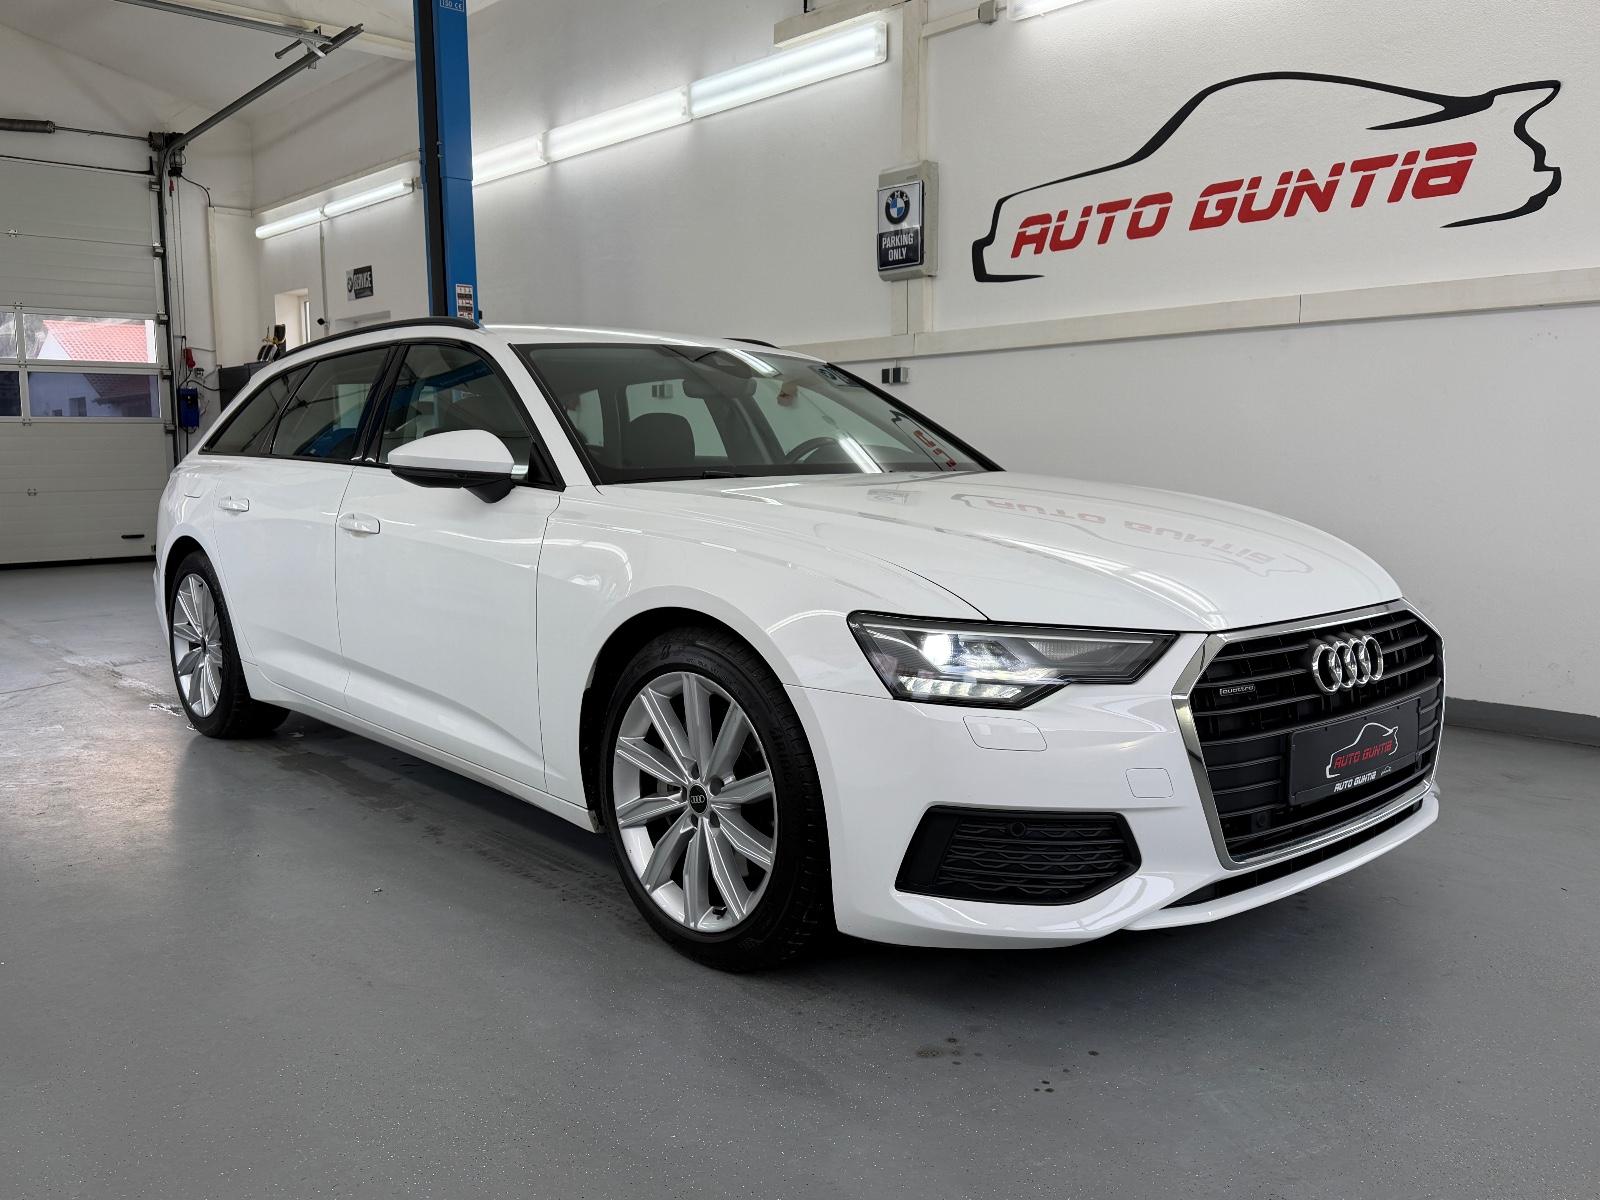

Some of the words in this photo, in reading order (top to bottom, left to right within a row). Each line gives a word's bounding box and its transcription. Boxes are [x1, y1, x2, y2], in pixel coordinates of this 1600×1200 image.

[1010, 191, 1174, 258] AUTO
[882, 233, 913, 248] PARKING
[888, 247, 907, 261] ONLY
[1221, 684, 1254, 695] quattro
[1334, 751, 1360, 769] AUTO
[1334, 779, 1353, 792] AUTO
